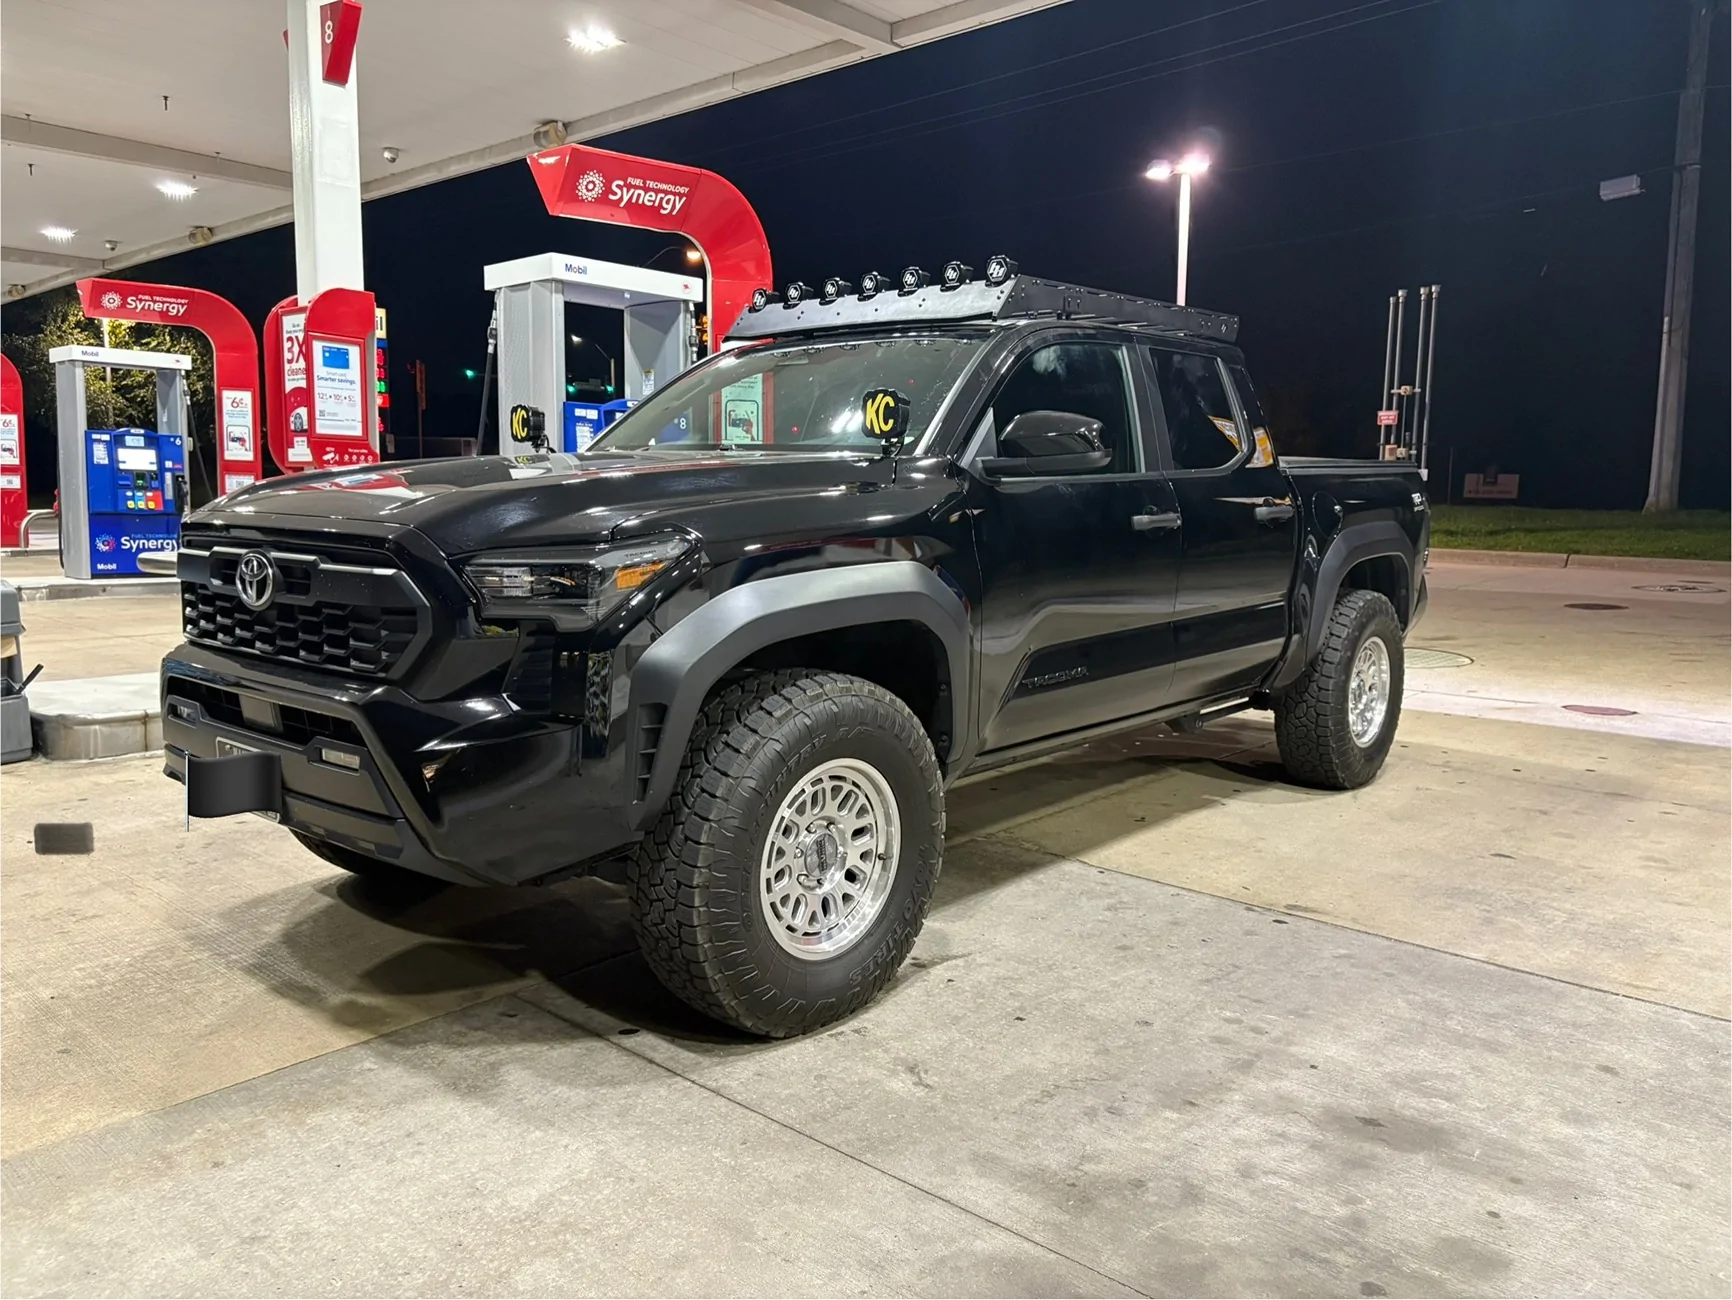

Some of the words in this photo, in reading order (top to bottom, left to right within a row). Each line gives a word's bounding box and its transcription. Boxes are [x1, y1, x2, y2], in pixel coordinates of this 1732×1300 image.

[325, 20, 333, 43] 8
[627, 177, 644, 187] FUEL
[646, 180, 689, 194] TECHNOLOGY
[608, 180, 687, 215] Synergy
[564, 263, 588, 275] Mobil
[126, 297, 188, 316] Synergy
[153, 296, 189, 304] TECHNOLOGY
[286, 336, 306, 365] 3X
[287, 365, 307, 376] cleane
[865, 393, 895, 434] KC
[513, 408, 527, 439] KC
[680, 417, 687, 429] 8
[175, 437, 182, 446] 6
[624, 549, 657, 558] TACOMA
